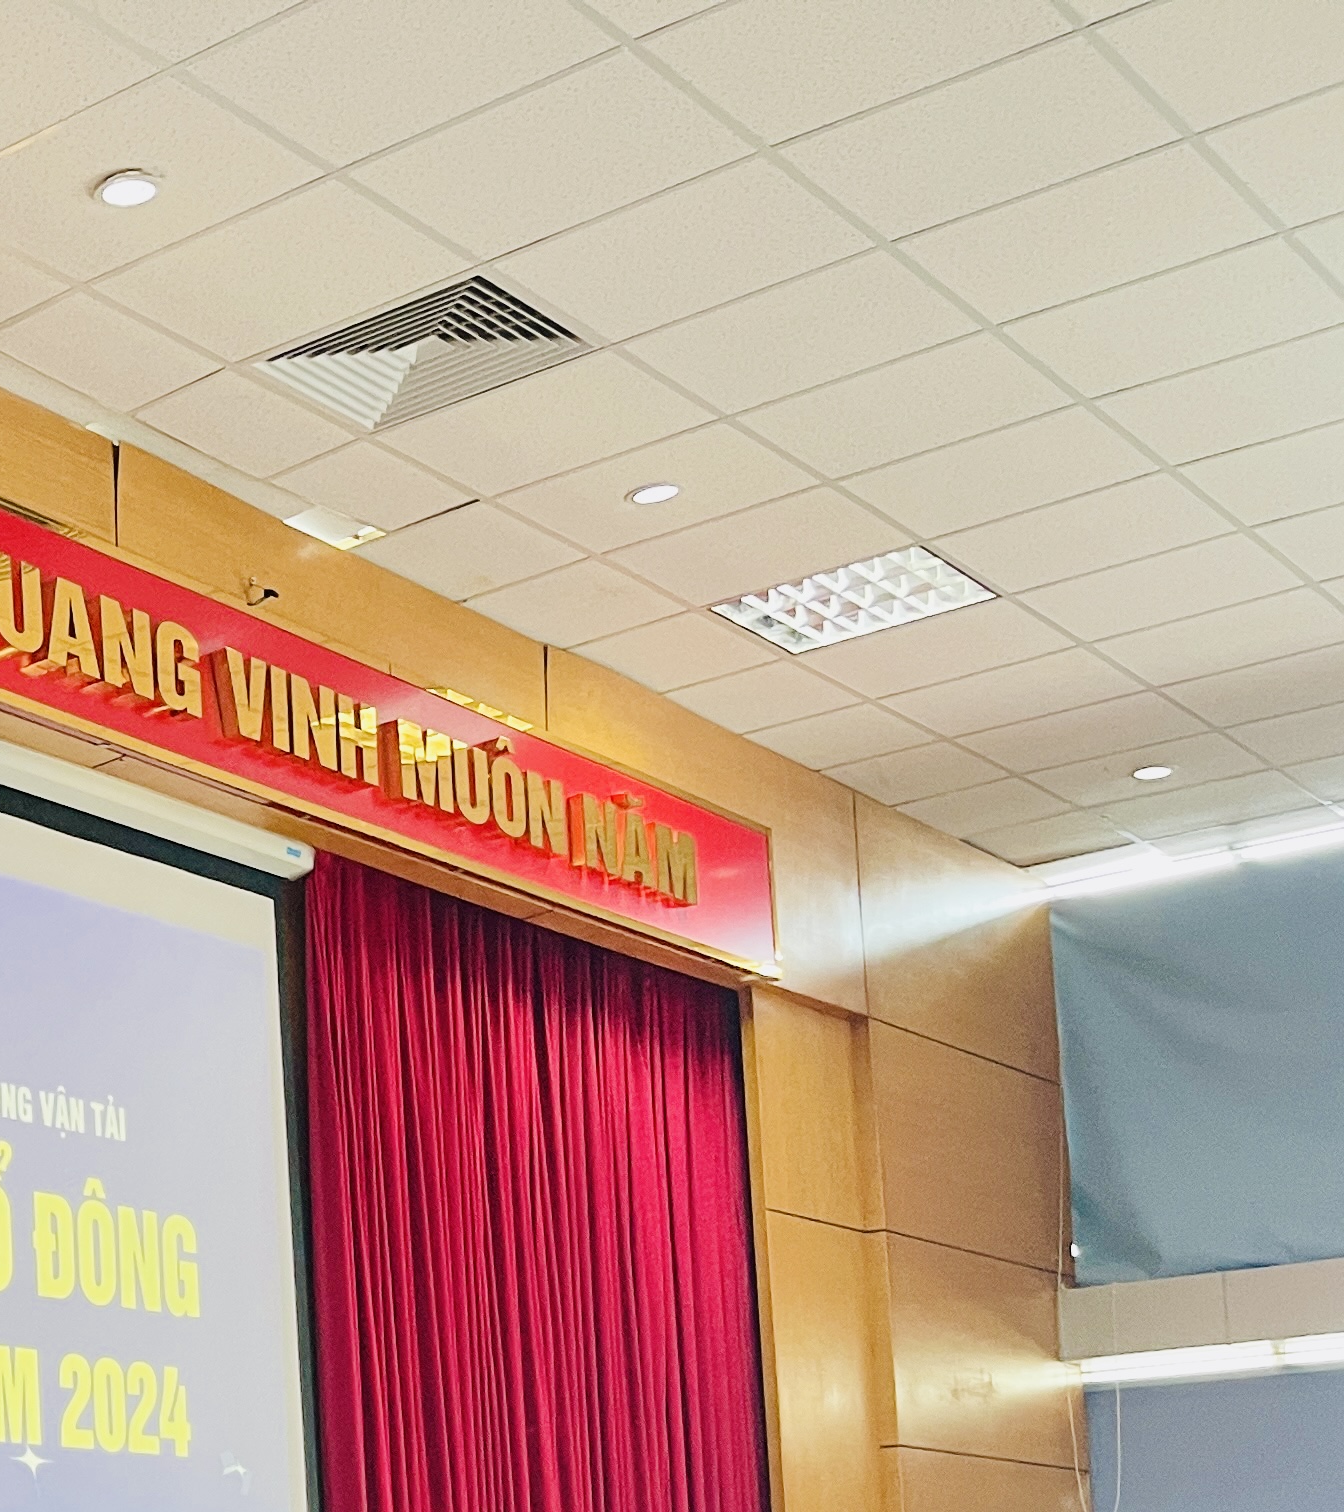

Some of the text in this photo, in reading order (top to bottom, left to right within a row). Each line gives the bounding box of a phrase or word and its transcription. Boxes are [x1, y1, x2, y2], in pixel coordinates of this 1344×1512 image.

[224, 645, 382, 788] VINH
[396, 717, 569, 856] MUÔN
[581, 791, 699, 906] NĂM
[38, 1085, 86, 1139] VẬN
[89, 1094, 128, 1142] TẢI
[31, 1176, 201, 1319] ĐÔNG
[58, 1352, 193, 1458] 2024
